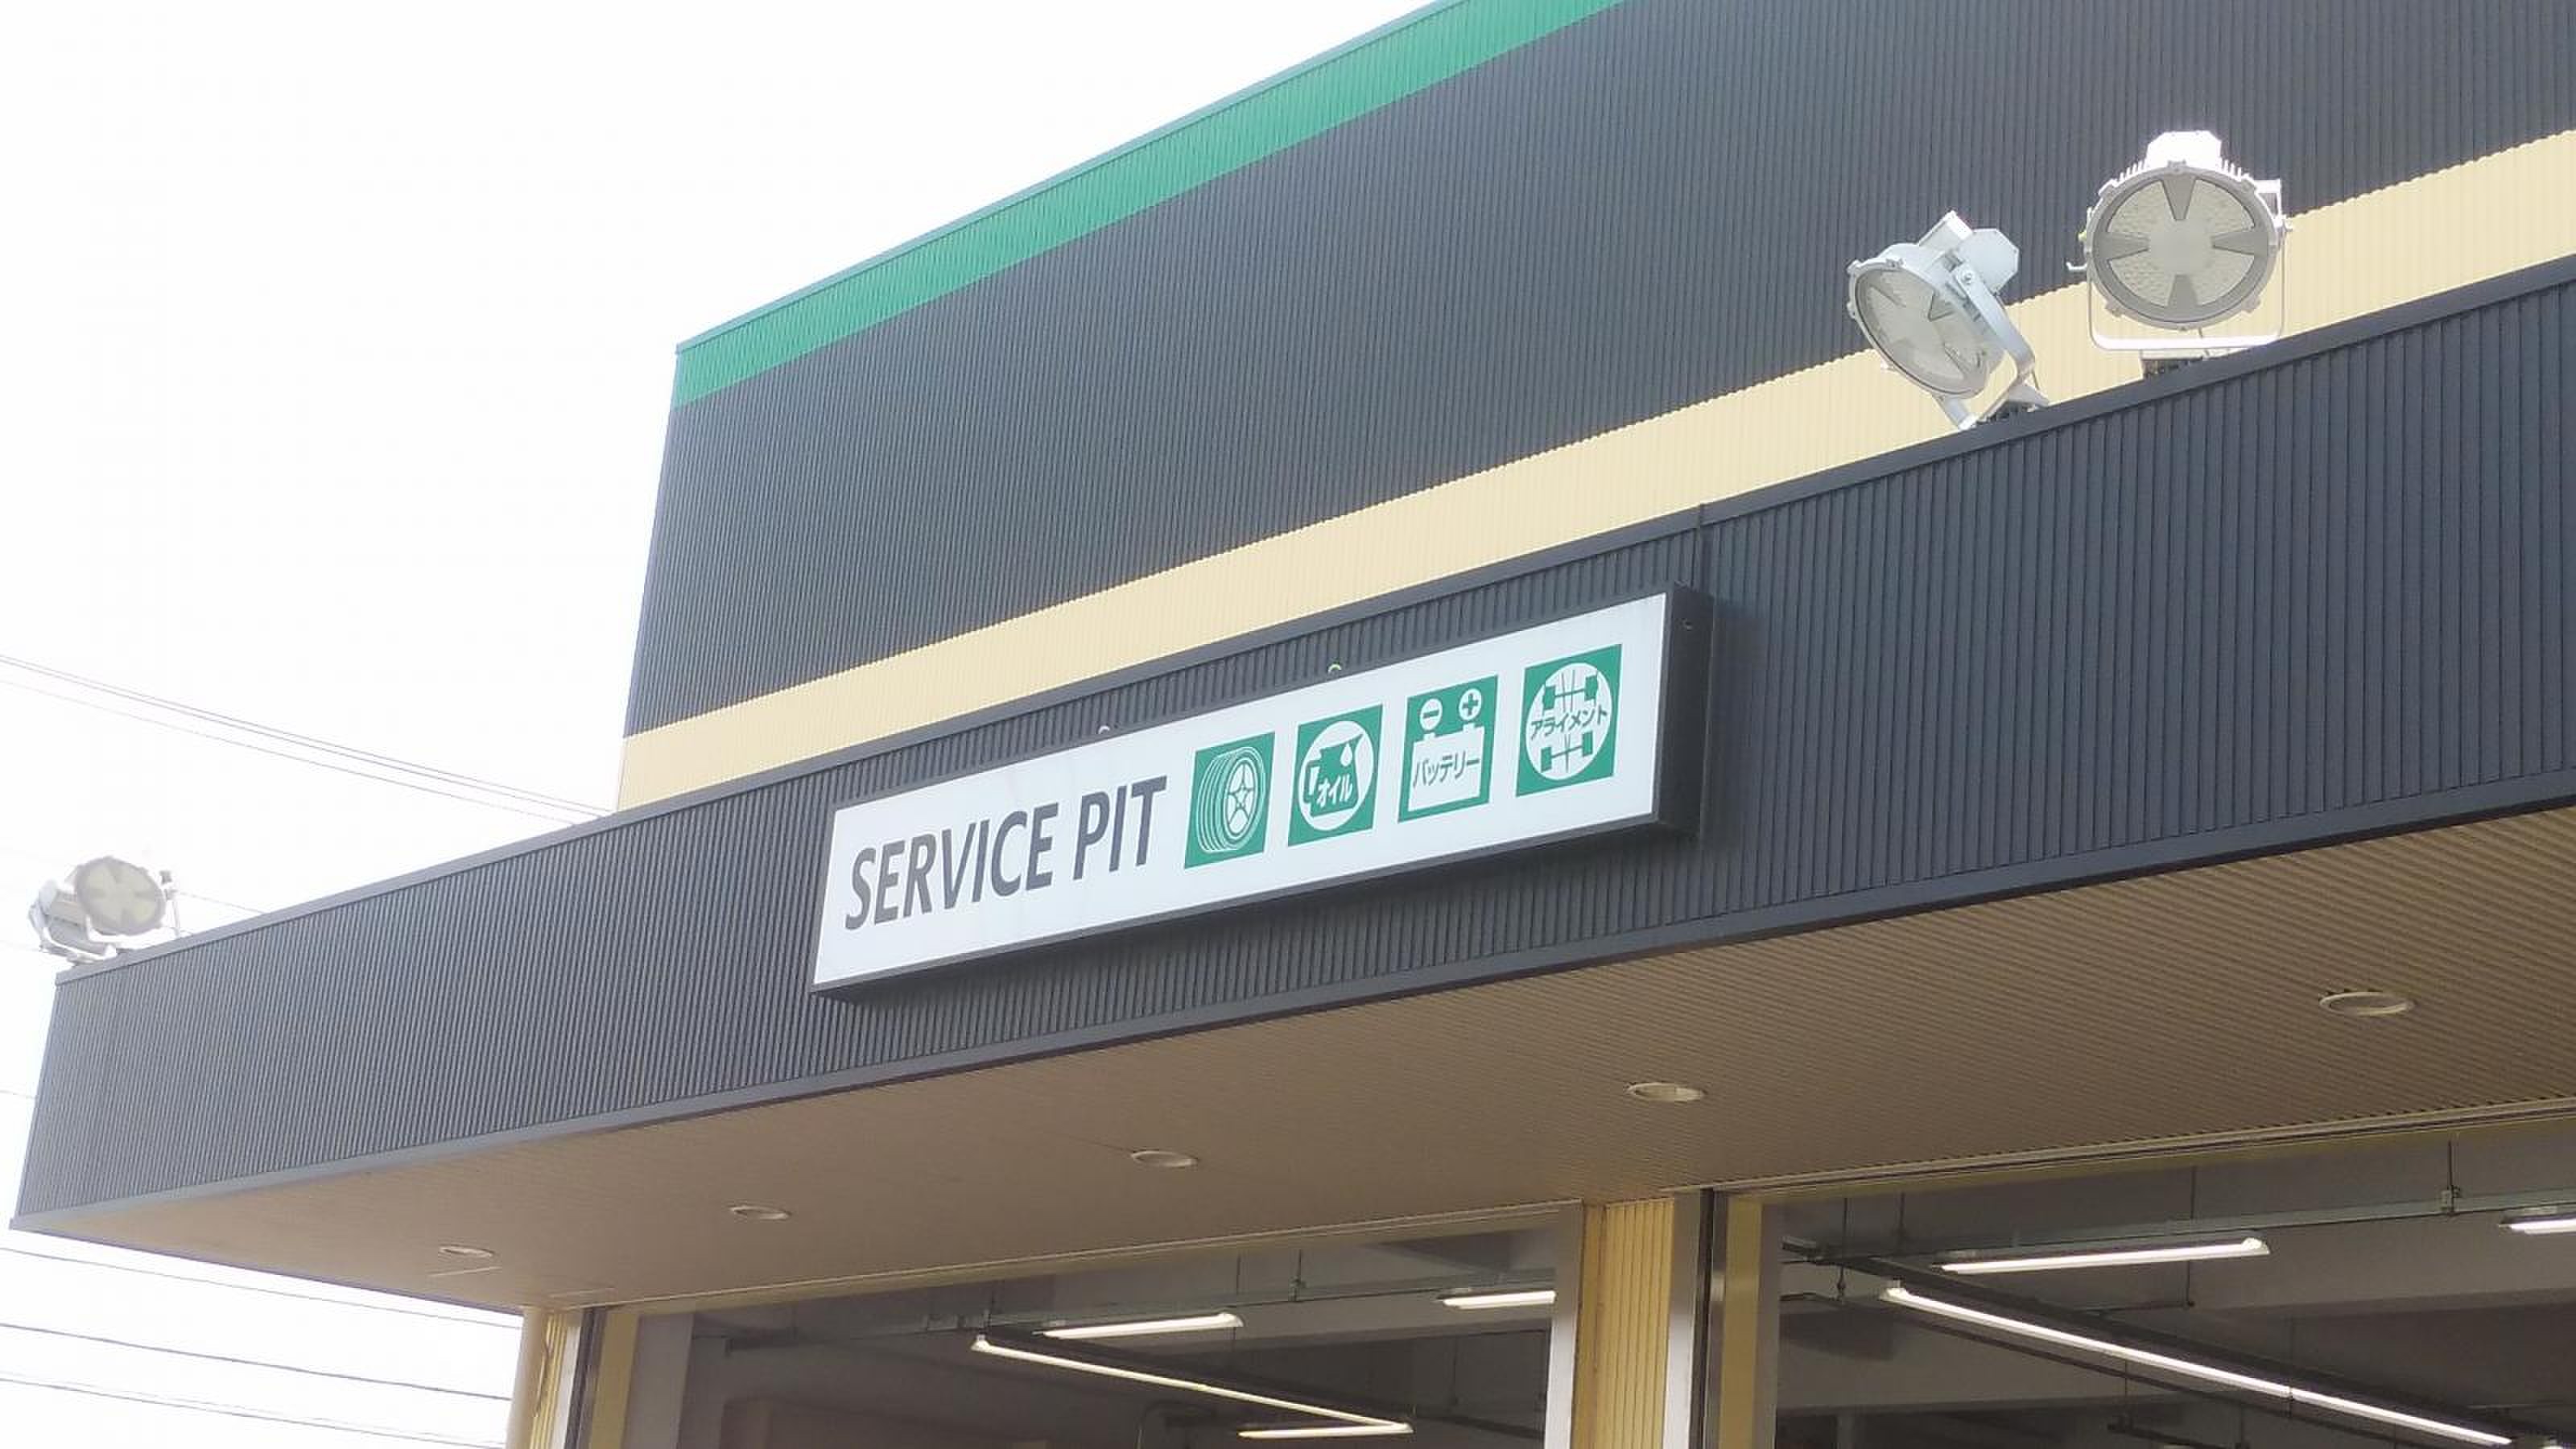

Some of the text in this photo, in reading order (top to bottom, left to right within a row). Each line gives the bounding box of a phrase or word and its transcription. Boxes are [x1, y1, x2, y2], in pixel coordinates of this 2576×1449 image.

[1530, 704, 1608, 741] アライメント
[1413, 750, 1480, 788] バッテリー
[1316, 774, 1353, 807] オイル
[845, 775, 1167, 930] SERVICE PIT
